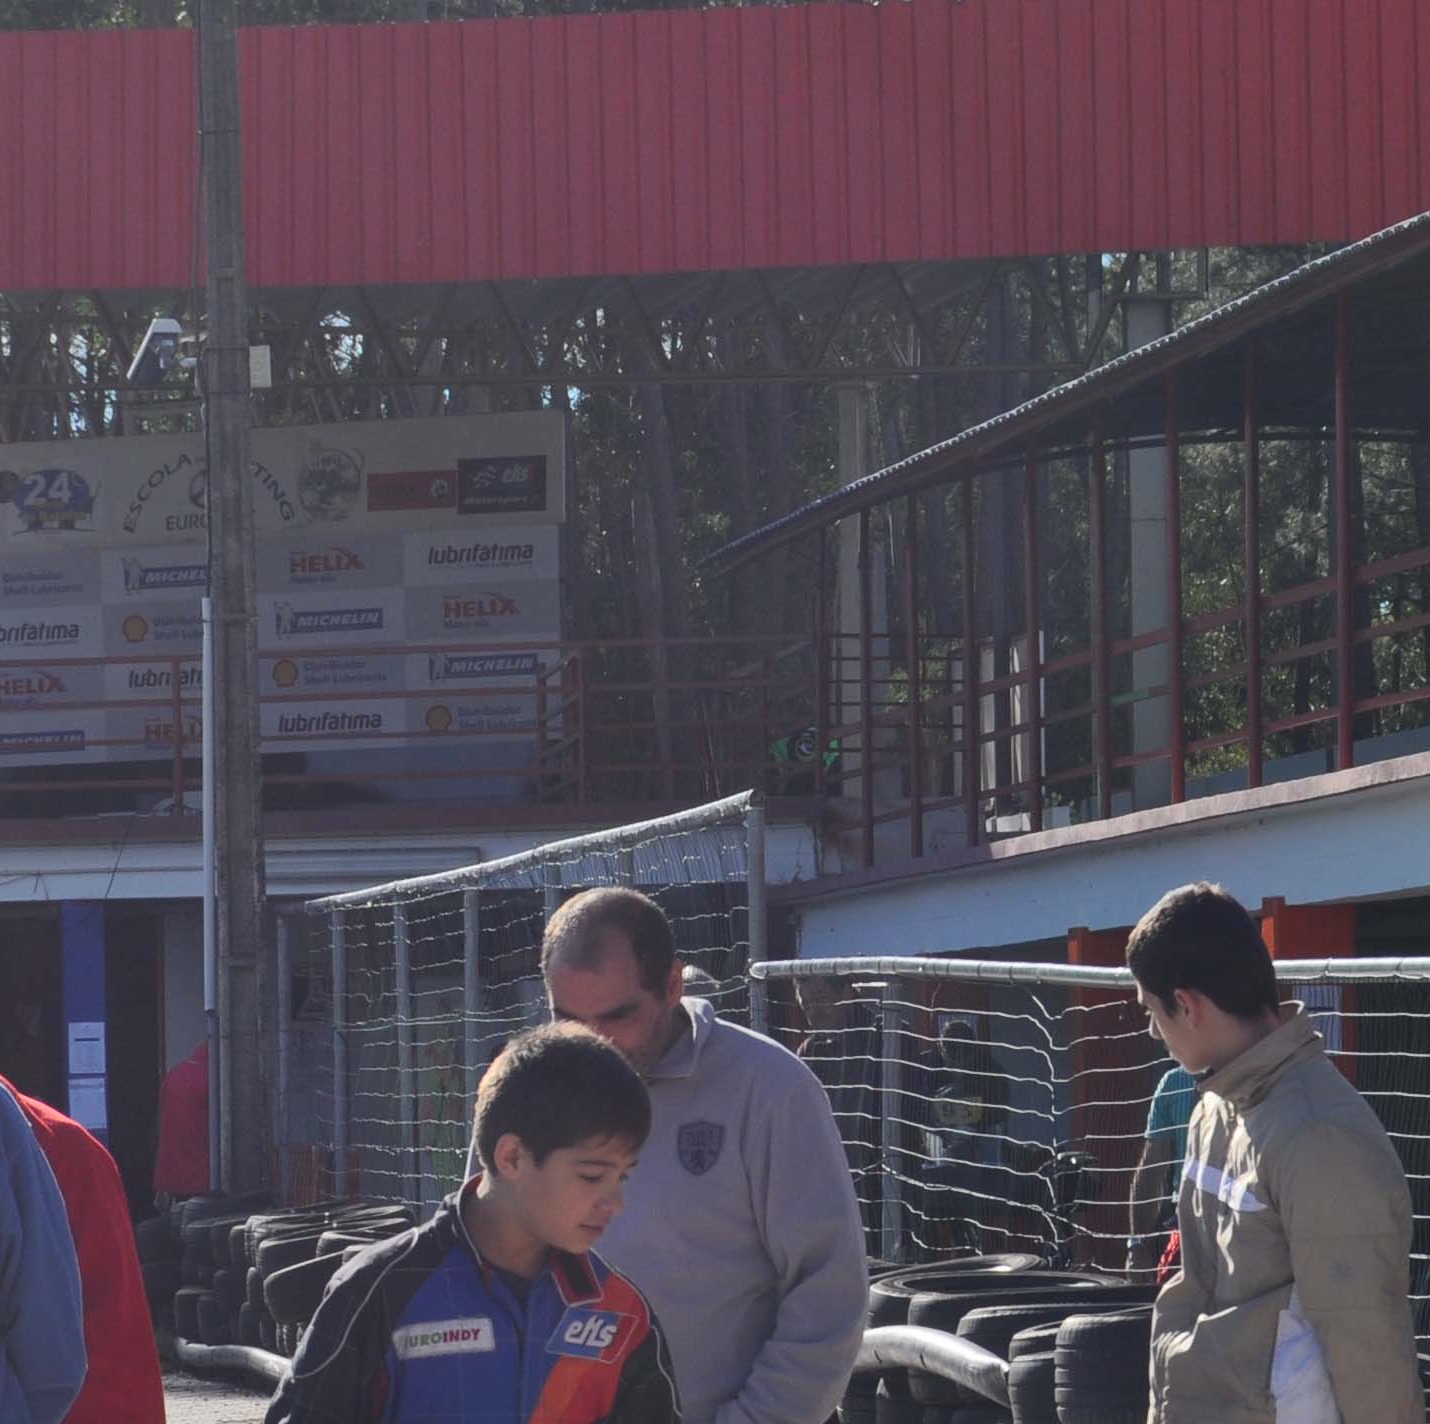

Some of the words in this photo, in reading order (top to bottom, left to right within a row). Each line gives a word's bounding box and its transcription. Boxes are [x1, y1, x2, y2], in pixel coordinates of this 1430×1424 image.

[24, 471, 74, 504] 24
[123, 454, 192, 534] ESCOLA
[251, 459, 295, 521] TING
[165, 513, 206, 532] EURO
[145, 567, 206, 584] MICHEL
[298, 611, 379, 627] MICHELIN
[451, 656, 534, 673] MICHELIN
